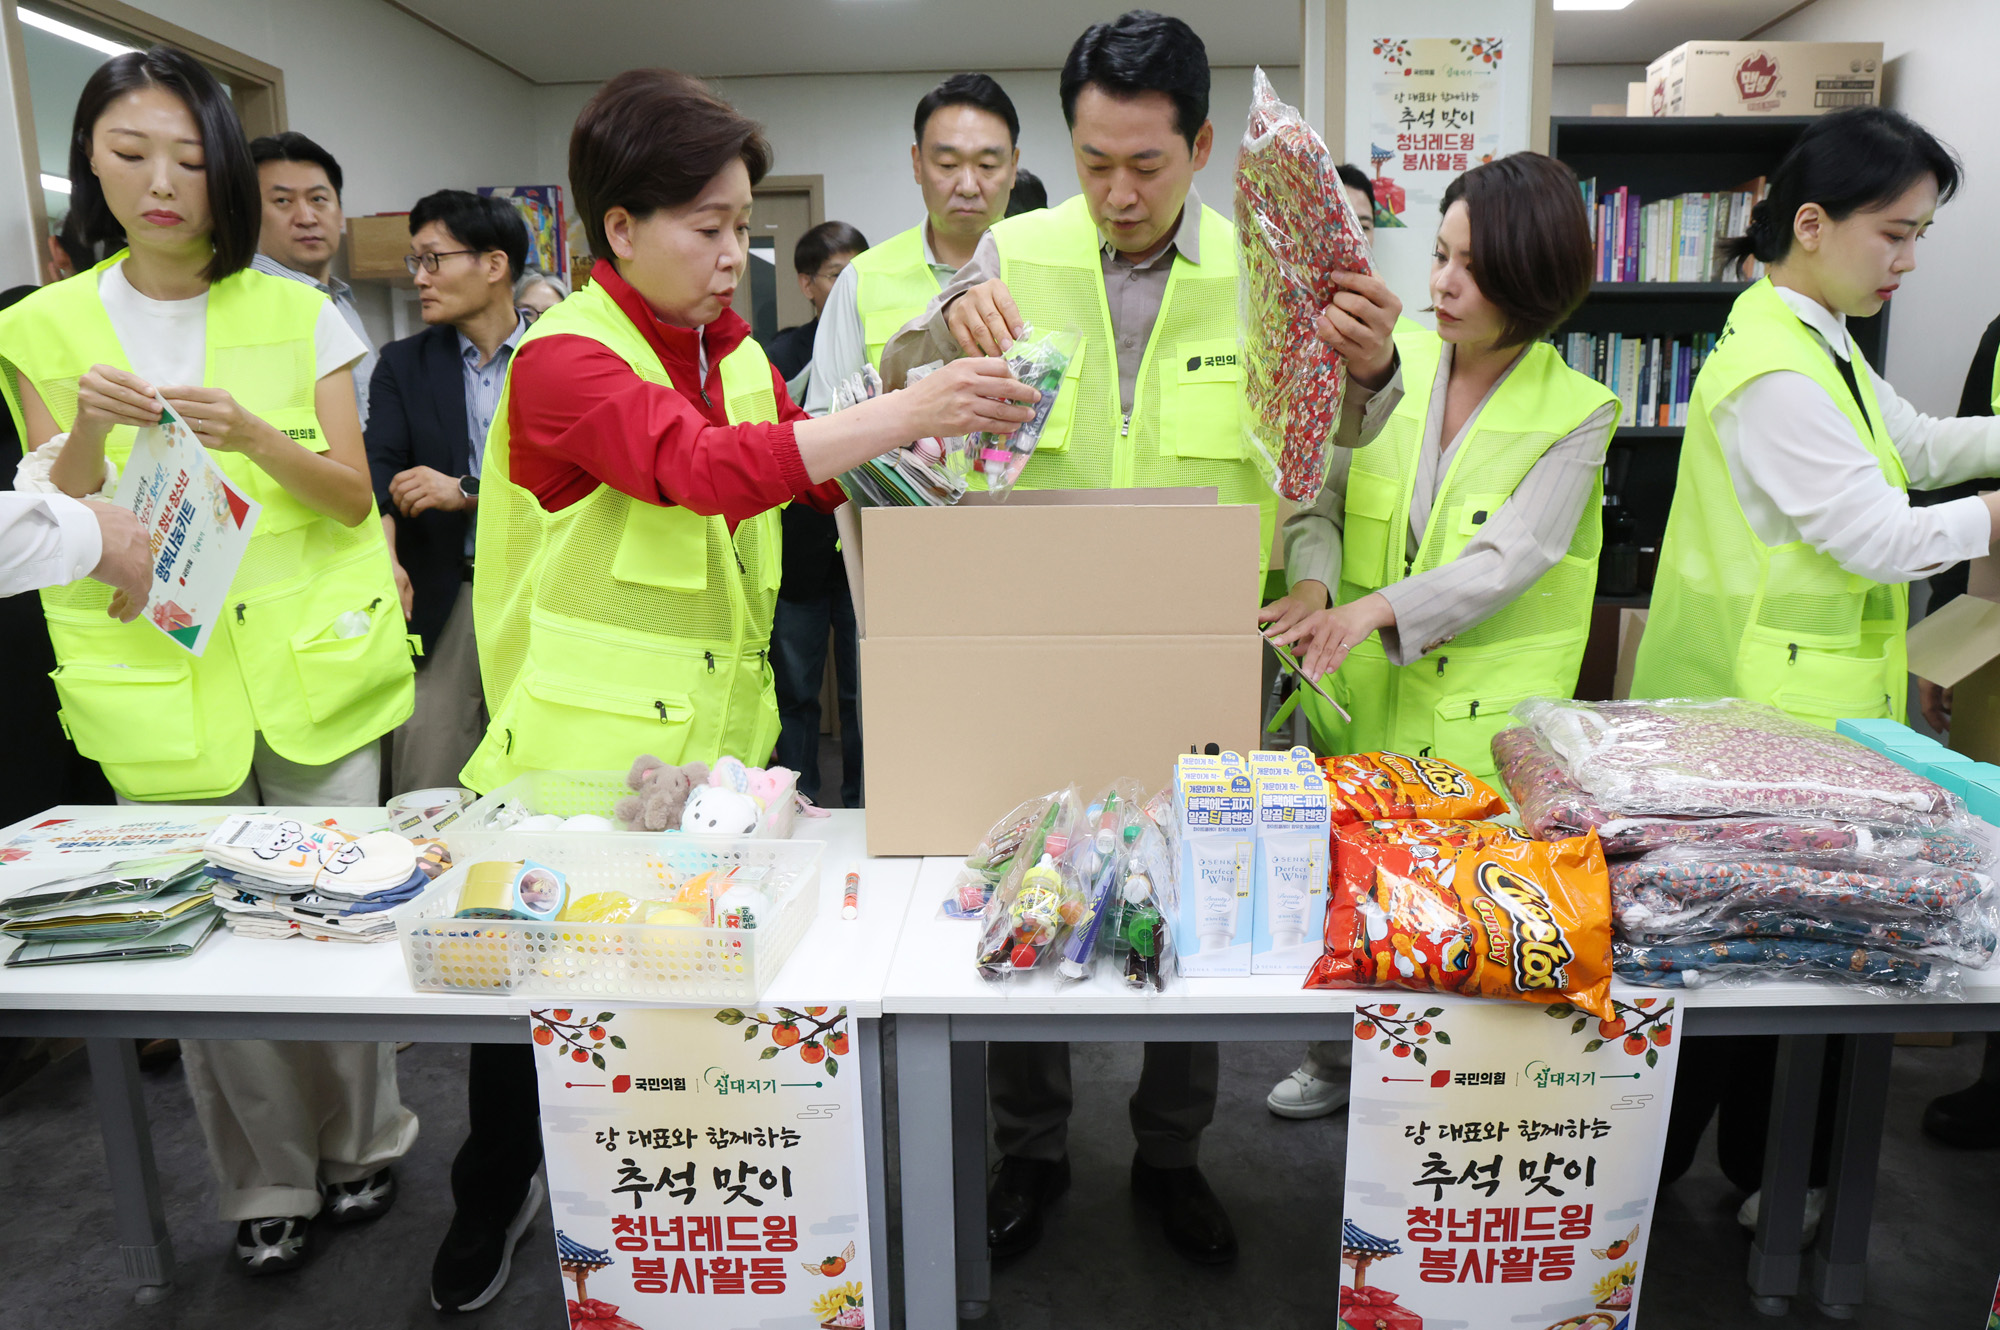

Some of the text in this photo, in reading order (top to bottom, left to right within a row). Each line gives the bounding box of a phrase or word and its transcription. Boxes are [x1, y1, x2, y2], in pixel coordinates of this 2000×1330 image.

[1394, 91, 1480, 103] 당 대표와 함께하는
[1398, 106, 1475, 131] 추석 맞이
[1396, 133, 1475, 151] 청년레드윙
[1403, 153, 1468, 171] 봉사활동
[1204, 354, 1236, 367] 국민의
[155, 498, 196, 583] 행복나눔키트
[1380, 754, 1420, 784] Crunchy
[1235, 778, 1248, 787] 15g
[399, 816, 421, 829] Scotch
[435, 813, 458, 831] Scotch
[288, 832, 327, 868] LOVE
[1201, 868, 1234, 879] Perfect
[1208, 875, 1235, 884] Whip
[1275, 865, 1307, 876] Perfect
[1281, 872, 1308, 882] Whip
[1473, 896, 1511, 968] Crunchy
[1479, 863, 1573, 991] Cheetos
[635, 1075, 777, 1095] 국민의힘 십대지기
[1454, 1068, 1596, 1088] 국민의힘 십대지기
[595, 1126, 802, 1151] 당 대표와 함께하는
[1404, 1117, 1612, 1145] 당 대표와 함께하는
[612, 1158, 793, 1209] 추석 맞이
[1413, 1152, 1597, 1202] 추석 맞이
[611, 1214, 799, 1252] 청년레드윙
[1406, 1203, 1594, 1243] 청년레드윙
[631, 1256, 788, 1295] 봉사활동
[1419, 1245, 1576, 1284] 봉사활동
